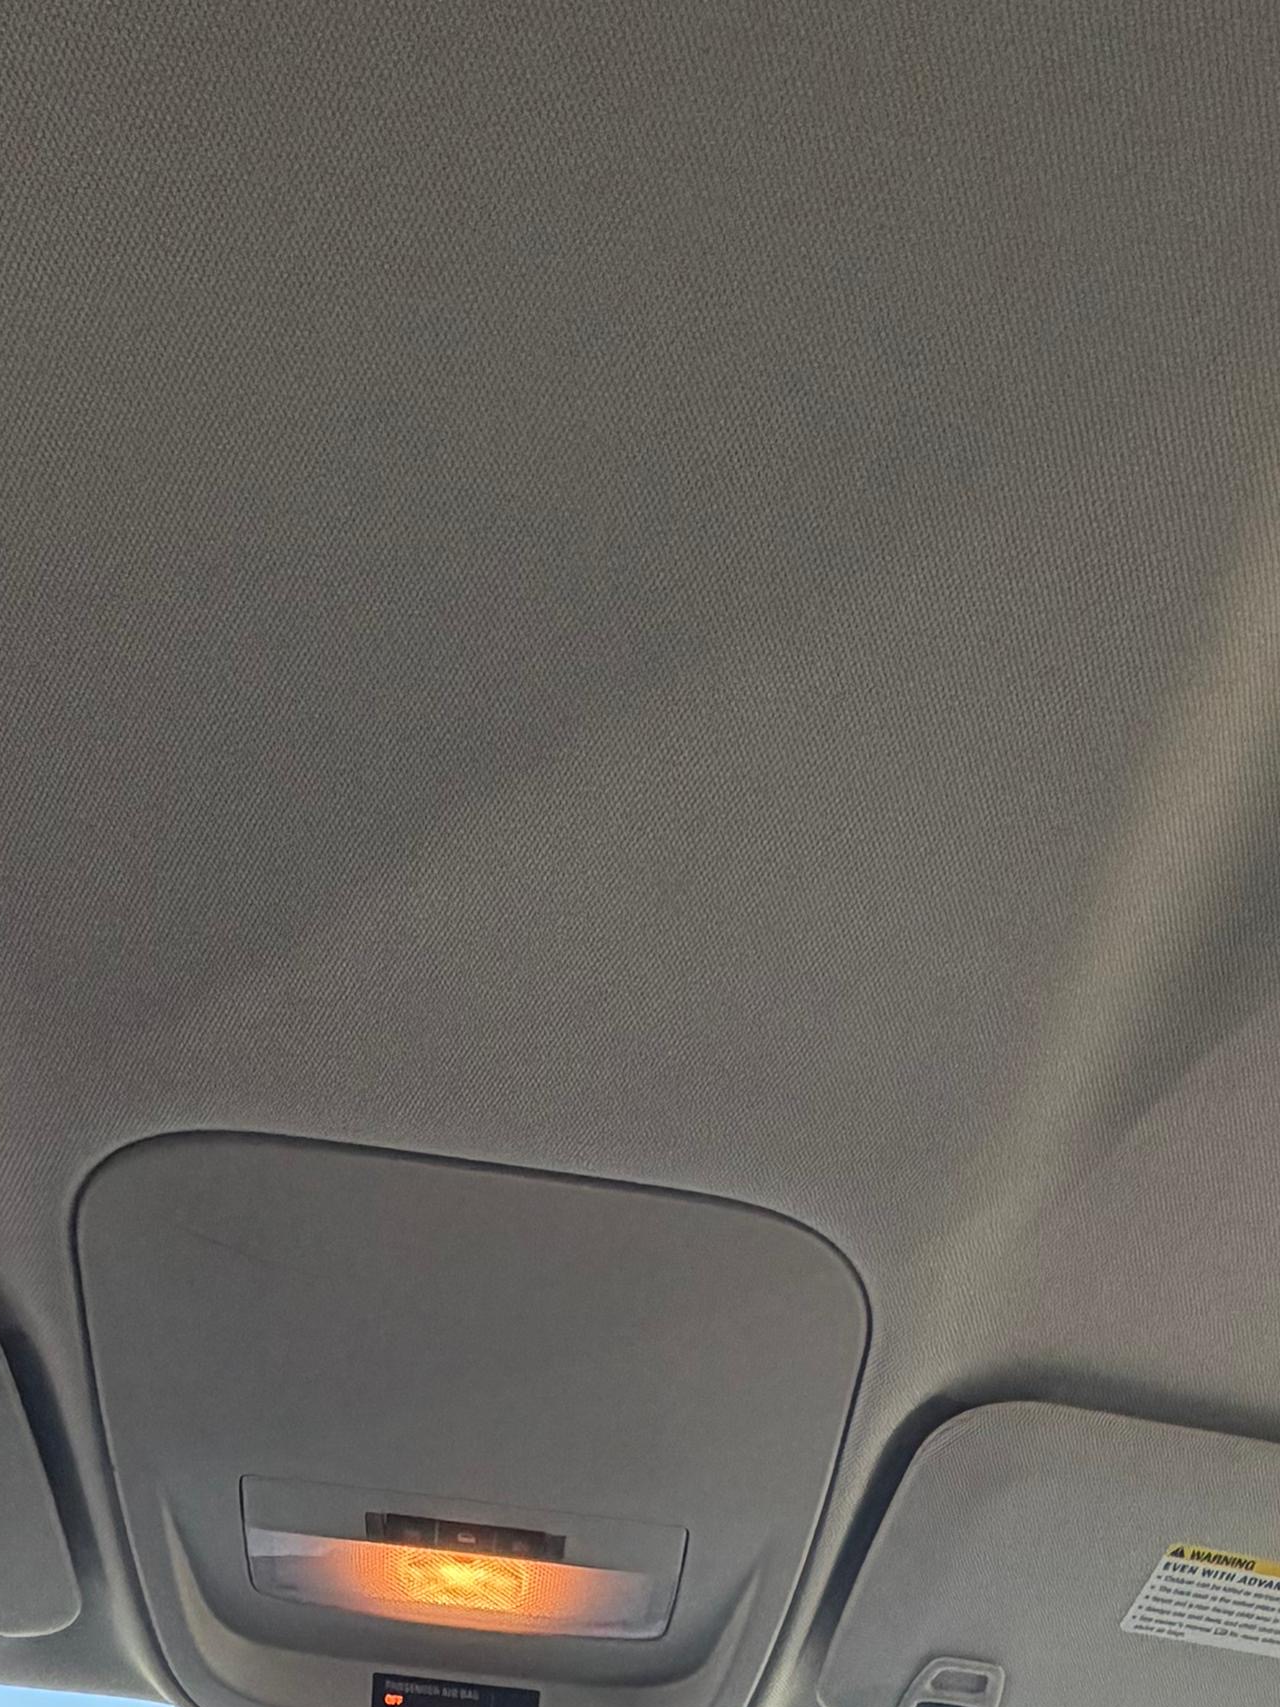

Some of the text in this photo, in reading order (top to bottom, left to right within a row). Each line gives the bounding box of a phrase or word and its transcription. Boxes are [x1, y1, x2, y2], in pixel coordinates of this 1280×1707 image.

[1189, 1549, 1257, 1572] WARNING
[1162, 1561, 1198, 1575] EVEN
[1201, 1568, 1237, 1583] WITH
